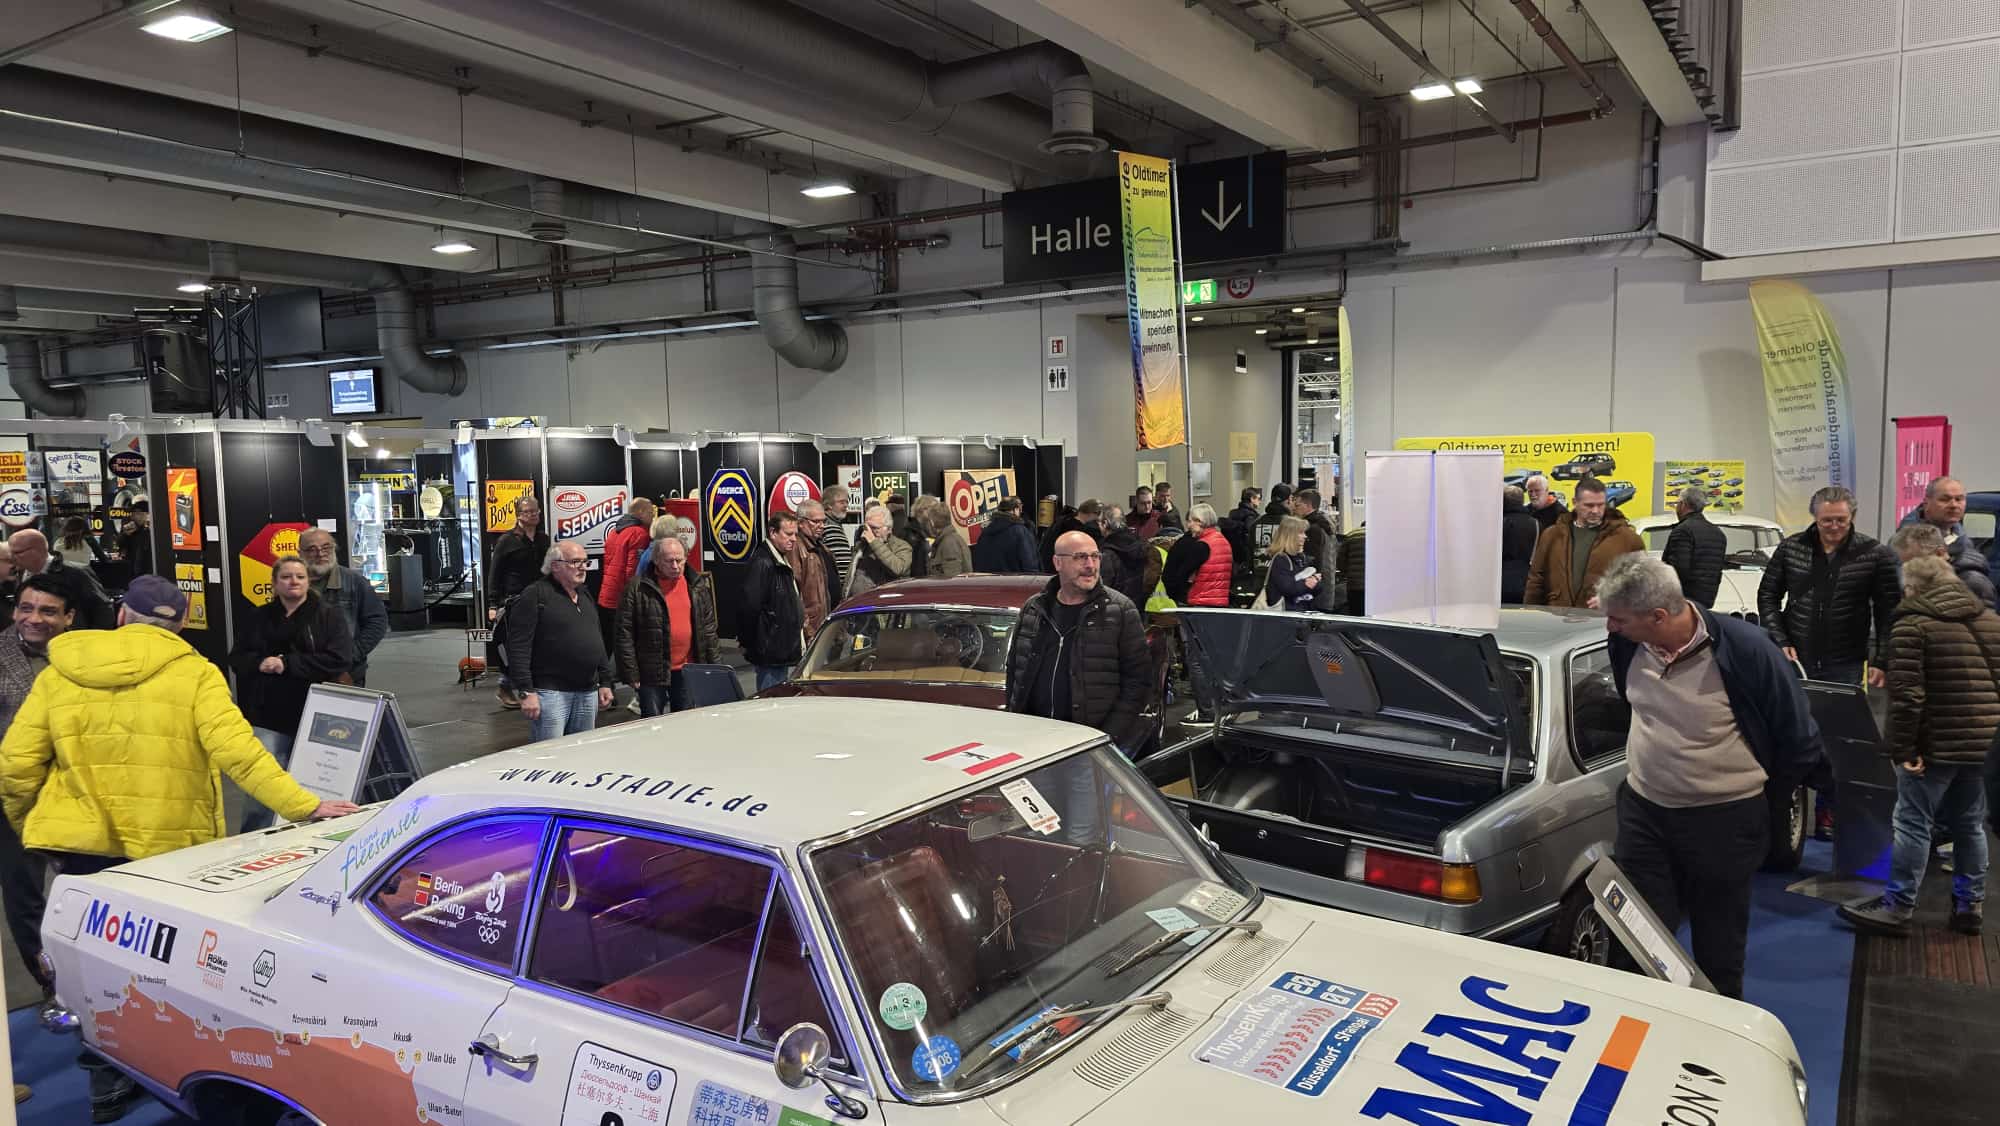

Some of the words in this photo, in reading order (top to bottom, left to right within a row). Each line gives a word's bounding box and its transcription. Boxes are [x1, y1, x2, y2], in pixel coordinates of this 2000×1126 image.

[1132, 164, 1168, 183] Oldtimer
[1132, 186, 1139, 196] zu
[1141, 188, 1168, 198] gewinnen!
[1031, 216, 1112, 256] Halle
[1147, 324, 1176, 337] spenden
[1510, 442, 1529, 455] zu
[1533, 437, 1621, 457] gewinnen!
[717, 486, 744, 495] AGENCE
[873, 476, 907, 489] OPEL
[1, 497, 31, 517] Ess
[954, 477, 1001, 520] OPEL
[561, 498, 620, 538] SERVICE
[176, 580, 203, 592] KONI
[499, 768, 769, 818] www.STADIE.de
[1021, 795, 1040, 814] 3
[433, 876, 464, 895] Berlin
[430, 894, 466, 920] Peking
[85, 898, 153, 955] Mobil
[157, 926, 170, 960] 1
[205, 962, 227, 974] Pharma
[1282, 975, 1322, 996] 20
[1319, 985, 1358, 1005] 07
[343, 1015, 379, 1030] Krasnojarsk
[230, 1050, 274, 1069] RUSSLAND
[426, 1051, 443, 1064] Ulan
[443, 1053, 457, 1065] Ude
[1359, 975, 1592, 1126] MAC
[589, 1053, 643, 1083] ThyssenKrupp
[1296, 1045, 1343, 1091] Düsseldorf
